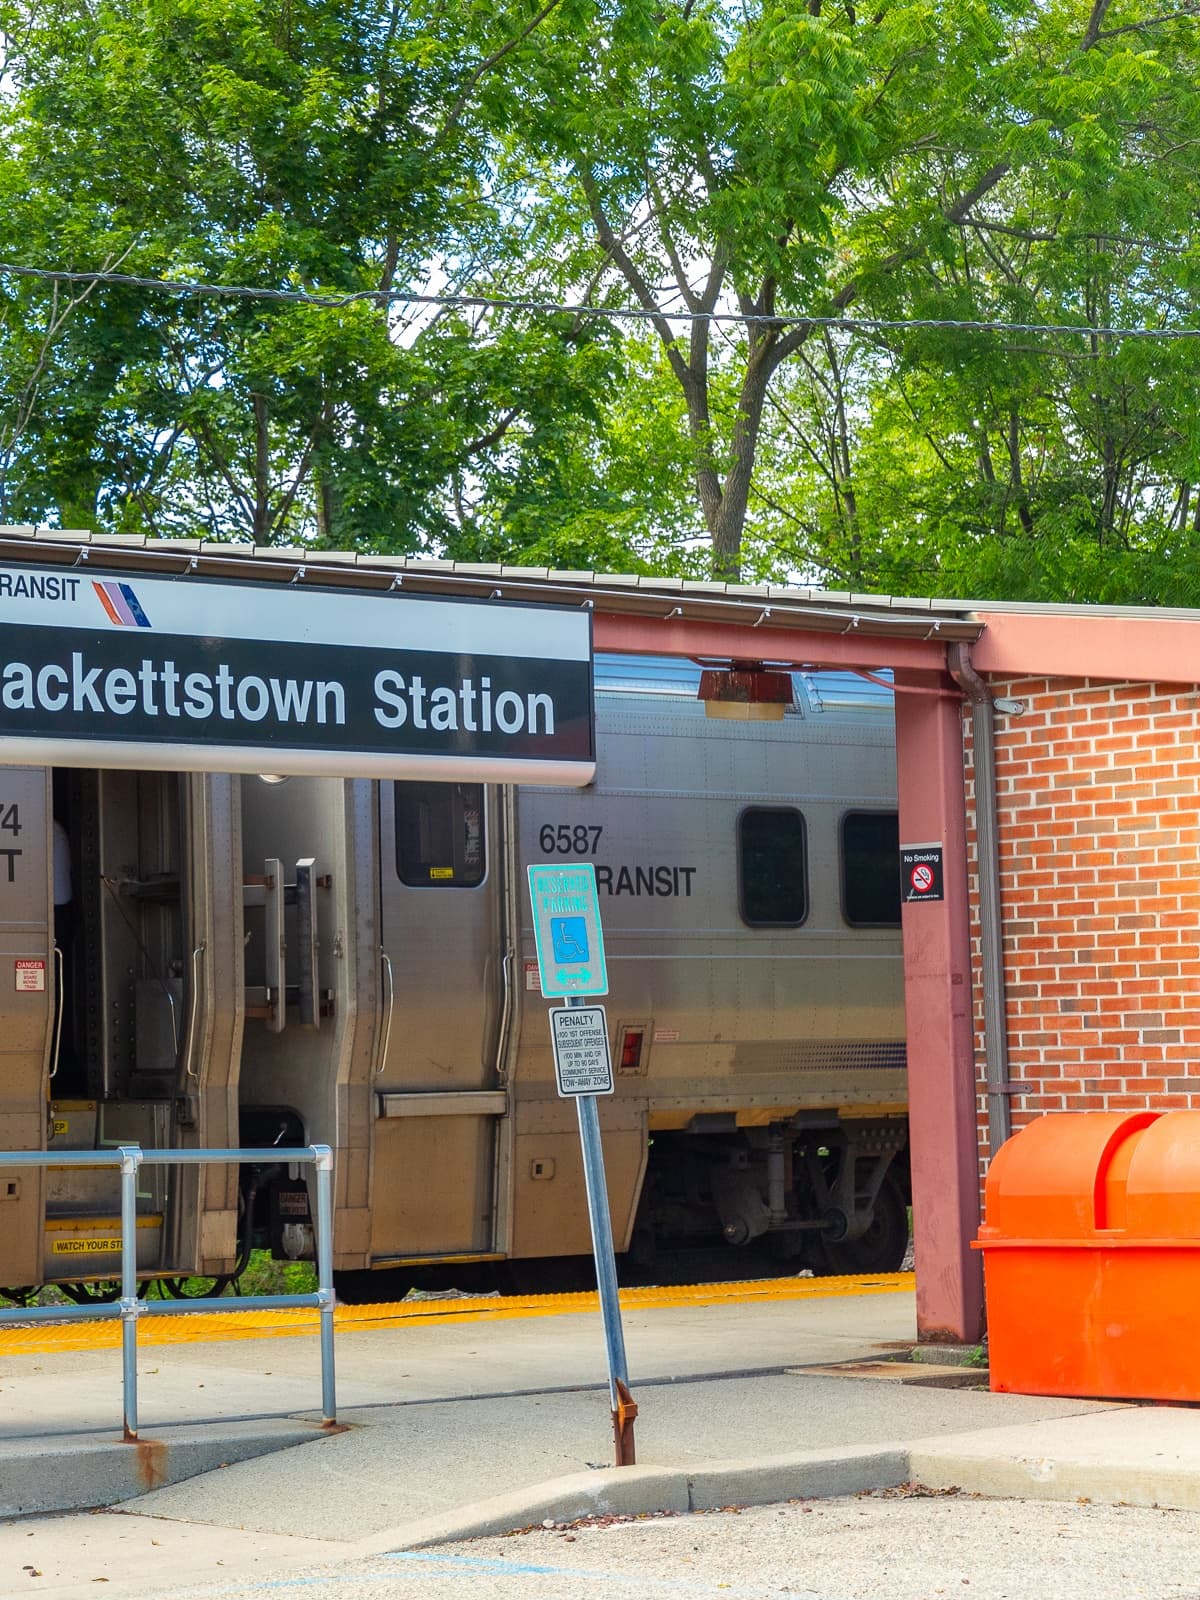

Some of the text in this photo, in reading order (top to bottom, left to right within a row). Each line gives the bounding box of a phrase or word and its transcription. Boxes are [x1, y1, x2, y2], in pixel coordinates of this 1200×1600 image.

[374, 669, 554, 735] Station
[539, 824, 603, 855] 6587
[904, 853, 939, 863] No Smoking
[537, 875, 589, 894] RESERVED
[595, 865, 697, 897] RANSIT
[543, 895, 588, 913] PARKING
[17, 961, 43, 969] DANGER
[559, 1015, 594, 1026] PENALTY
[57, 1240, 84, 1251] WATCH
[87, 1240, 108, 1250] YOUR
